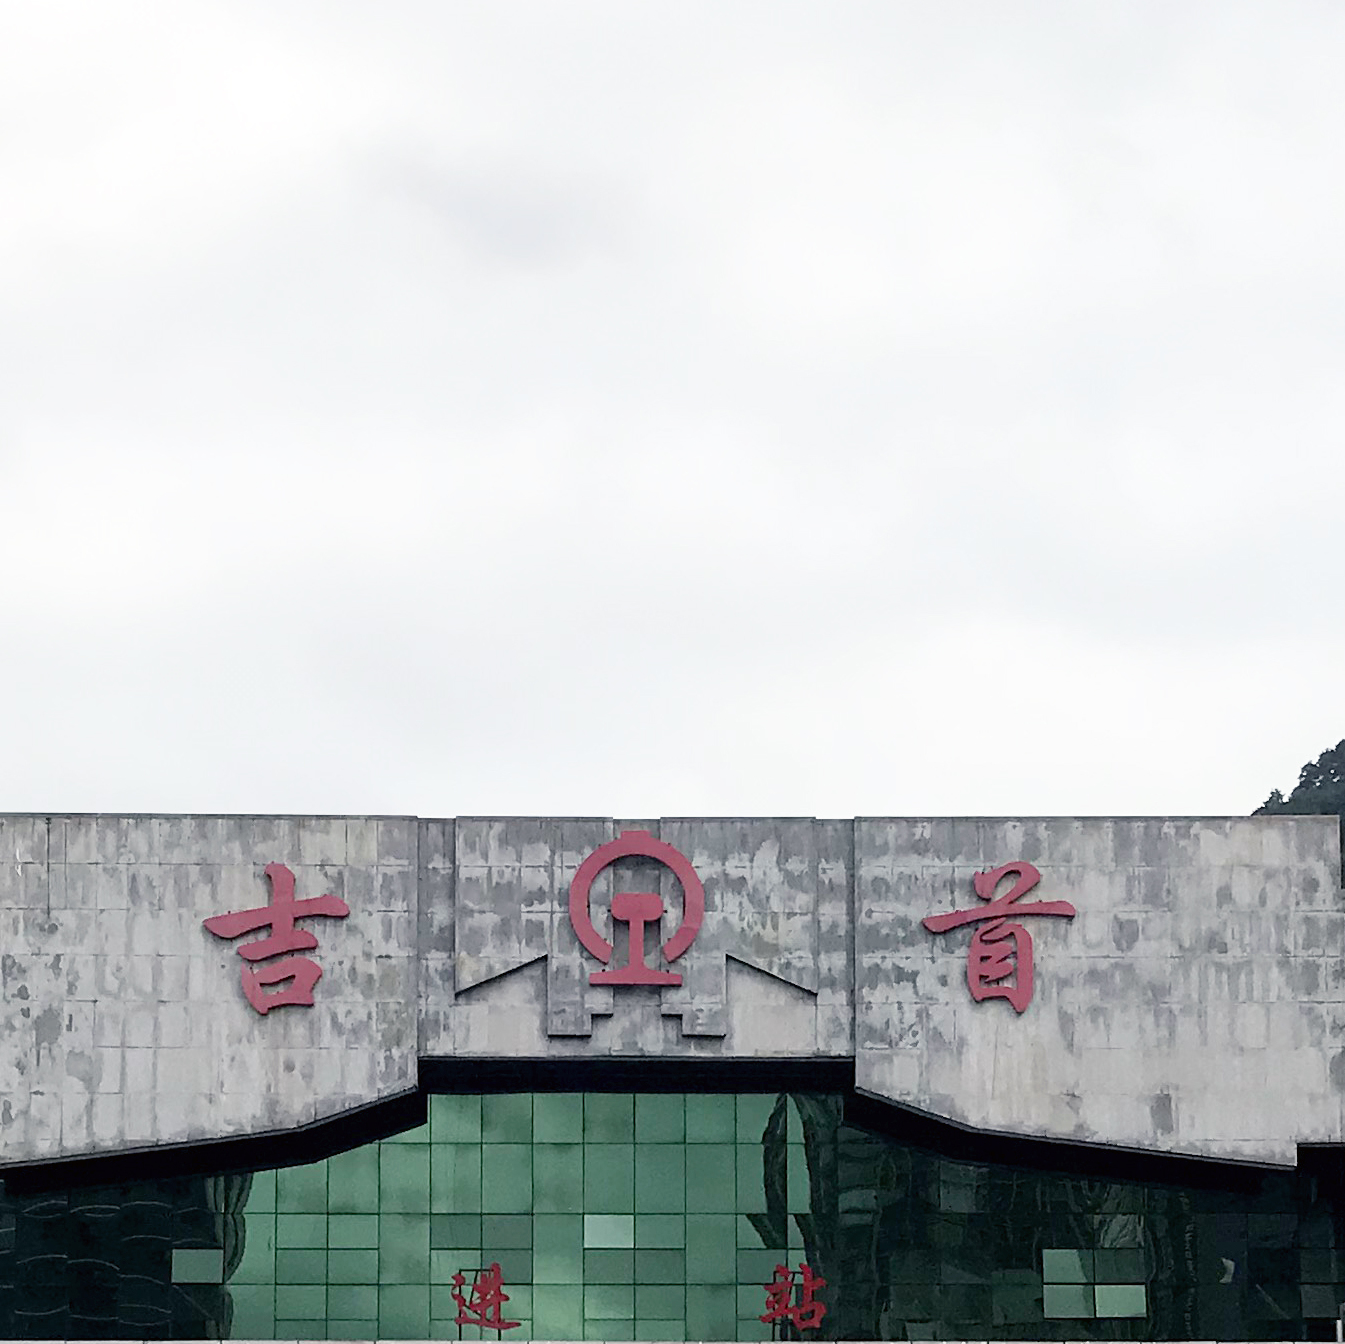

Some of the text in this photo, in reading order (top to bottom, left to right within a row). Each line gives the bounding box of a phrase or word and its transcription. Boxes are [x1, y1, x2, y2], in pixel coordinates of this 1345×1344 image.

[203, 861, 1076, 1014] 吉 首
[451, 1262, 826, 1331] 进 站
